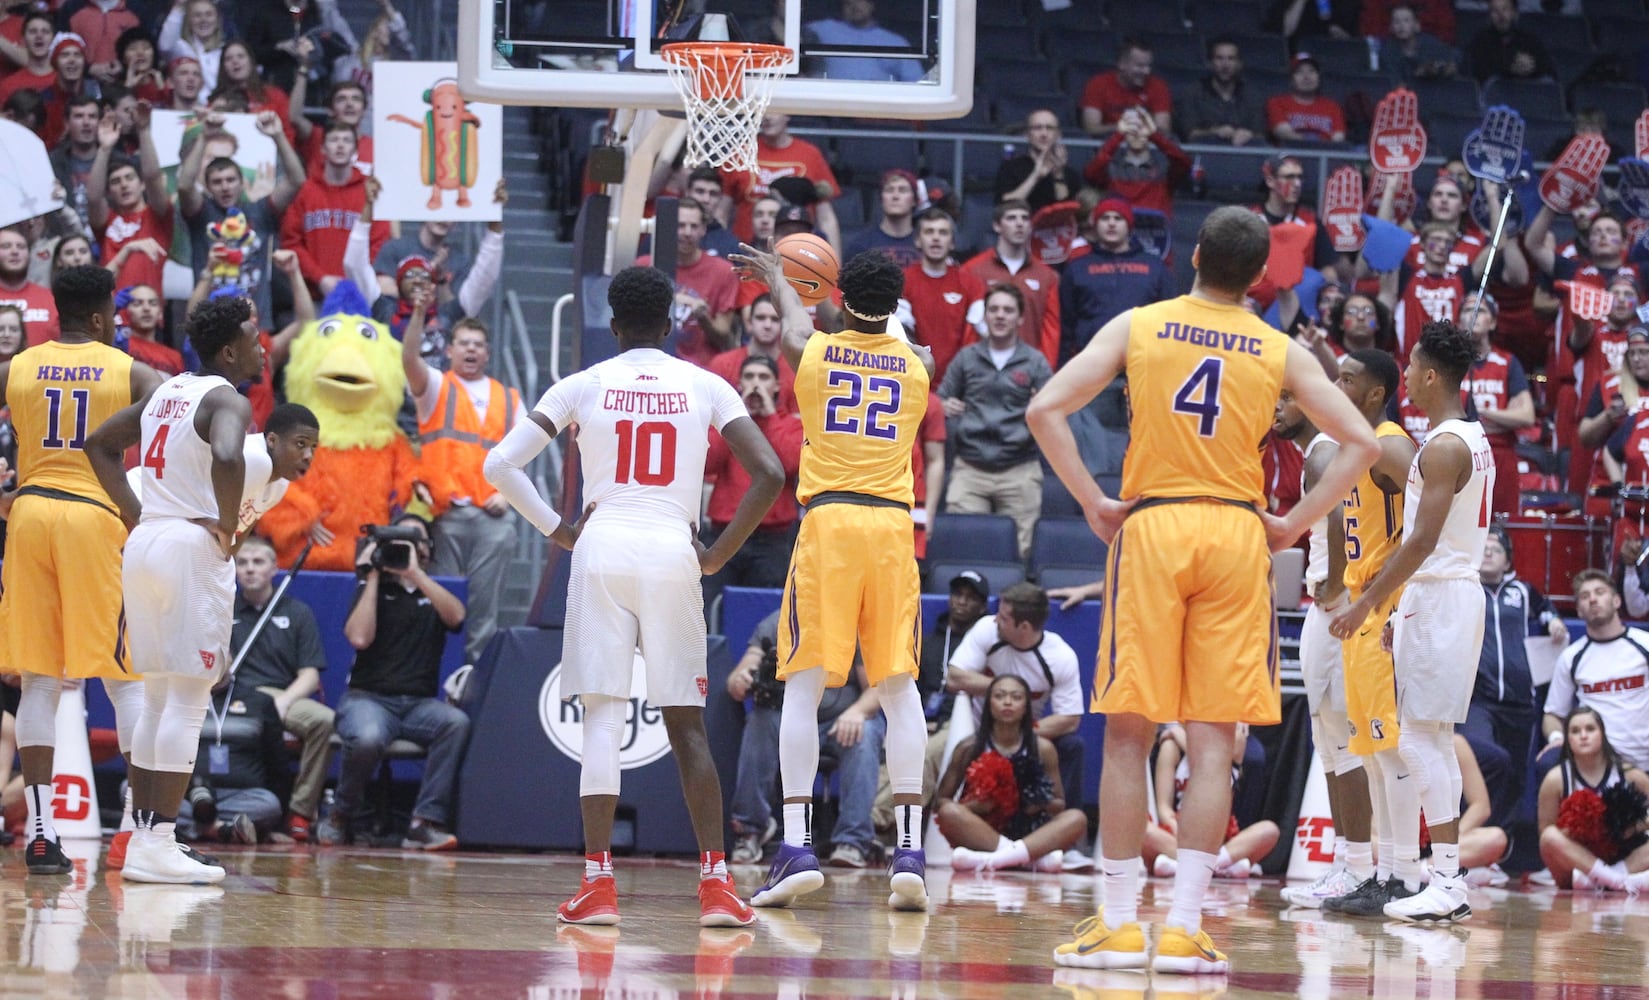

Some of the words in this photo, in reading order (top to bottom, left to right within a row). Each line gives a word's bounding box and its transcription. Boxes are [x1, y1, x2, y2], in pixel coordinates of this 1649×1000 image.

[303, 208, 362, 233] DAYTO
[823, 345, 907, 373] ALEXANDER
[1157, 322, 1263, 356] JUGOVIC
[37, 365, 105, 382] HENRY
[42, 387, 89, 451] 11
[603, 389, 690, 415] CRUTCHER
[824, 369, 902, 441] 22
[1172, 356, 1224, 438] 4
[144, 424, 170, 480] 4
[614, 419, 677, 487] 10
